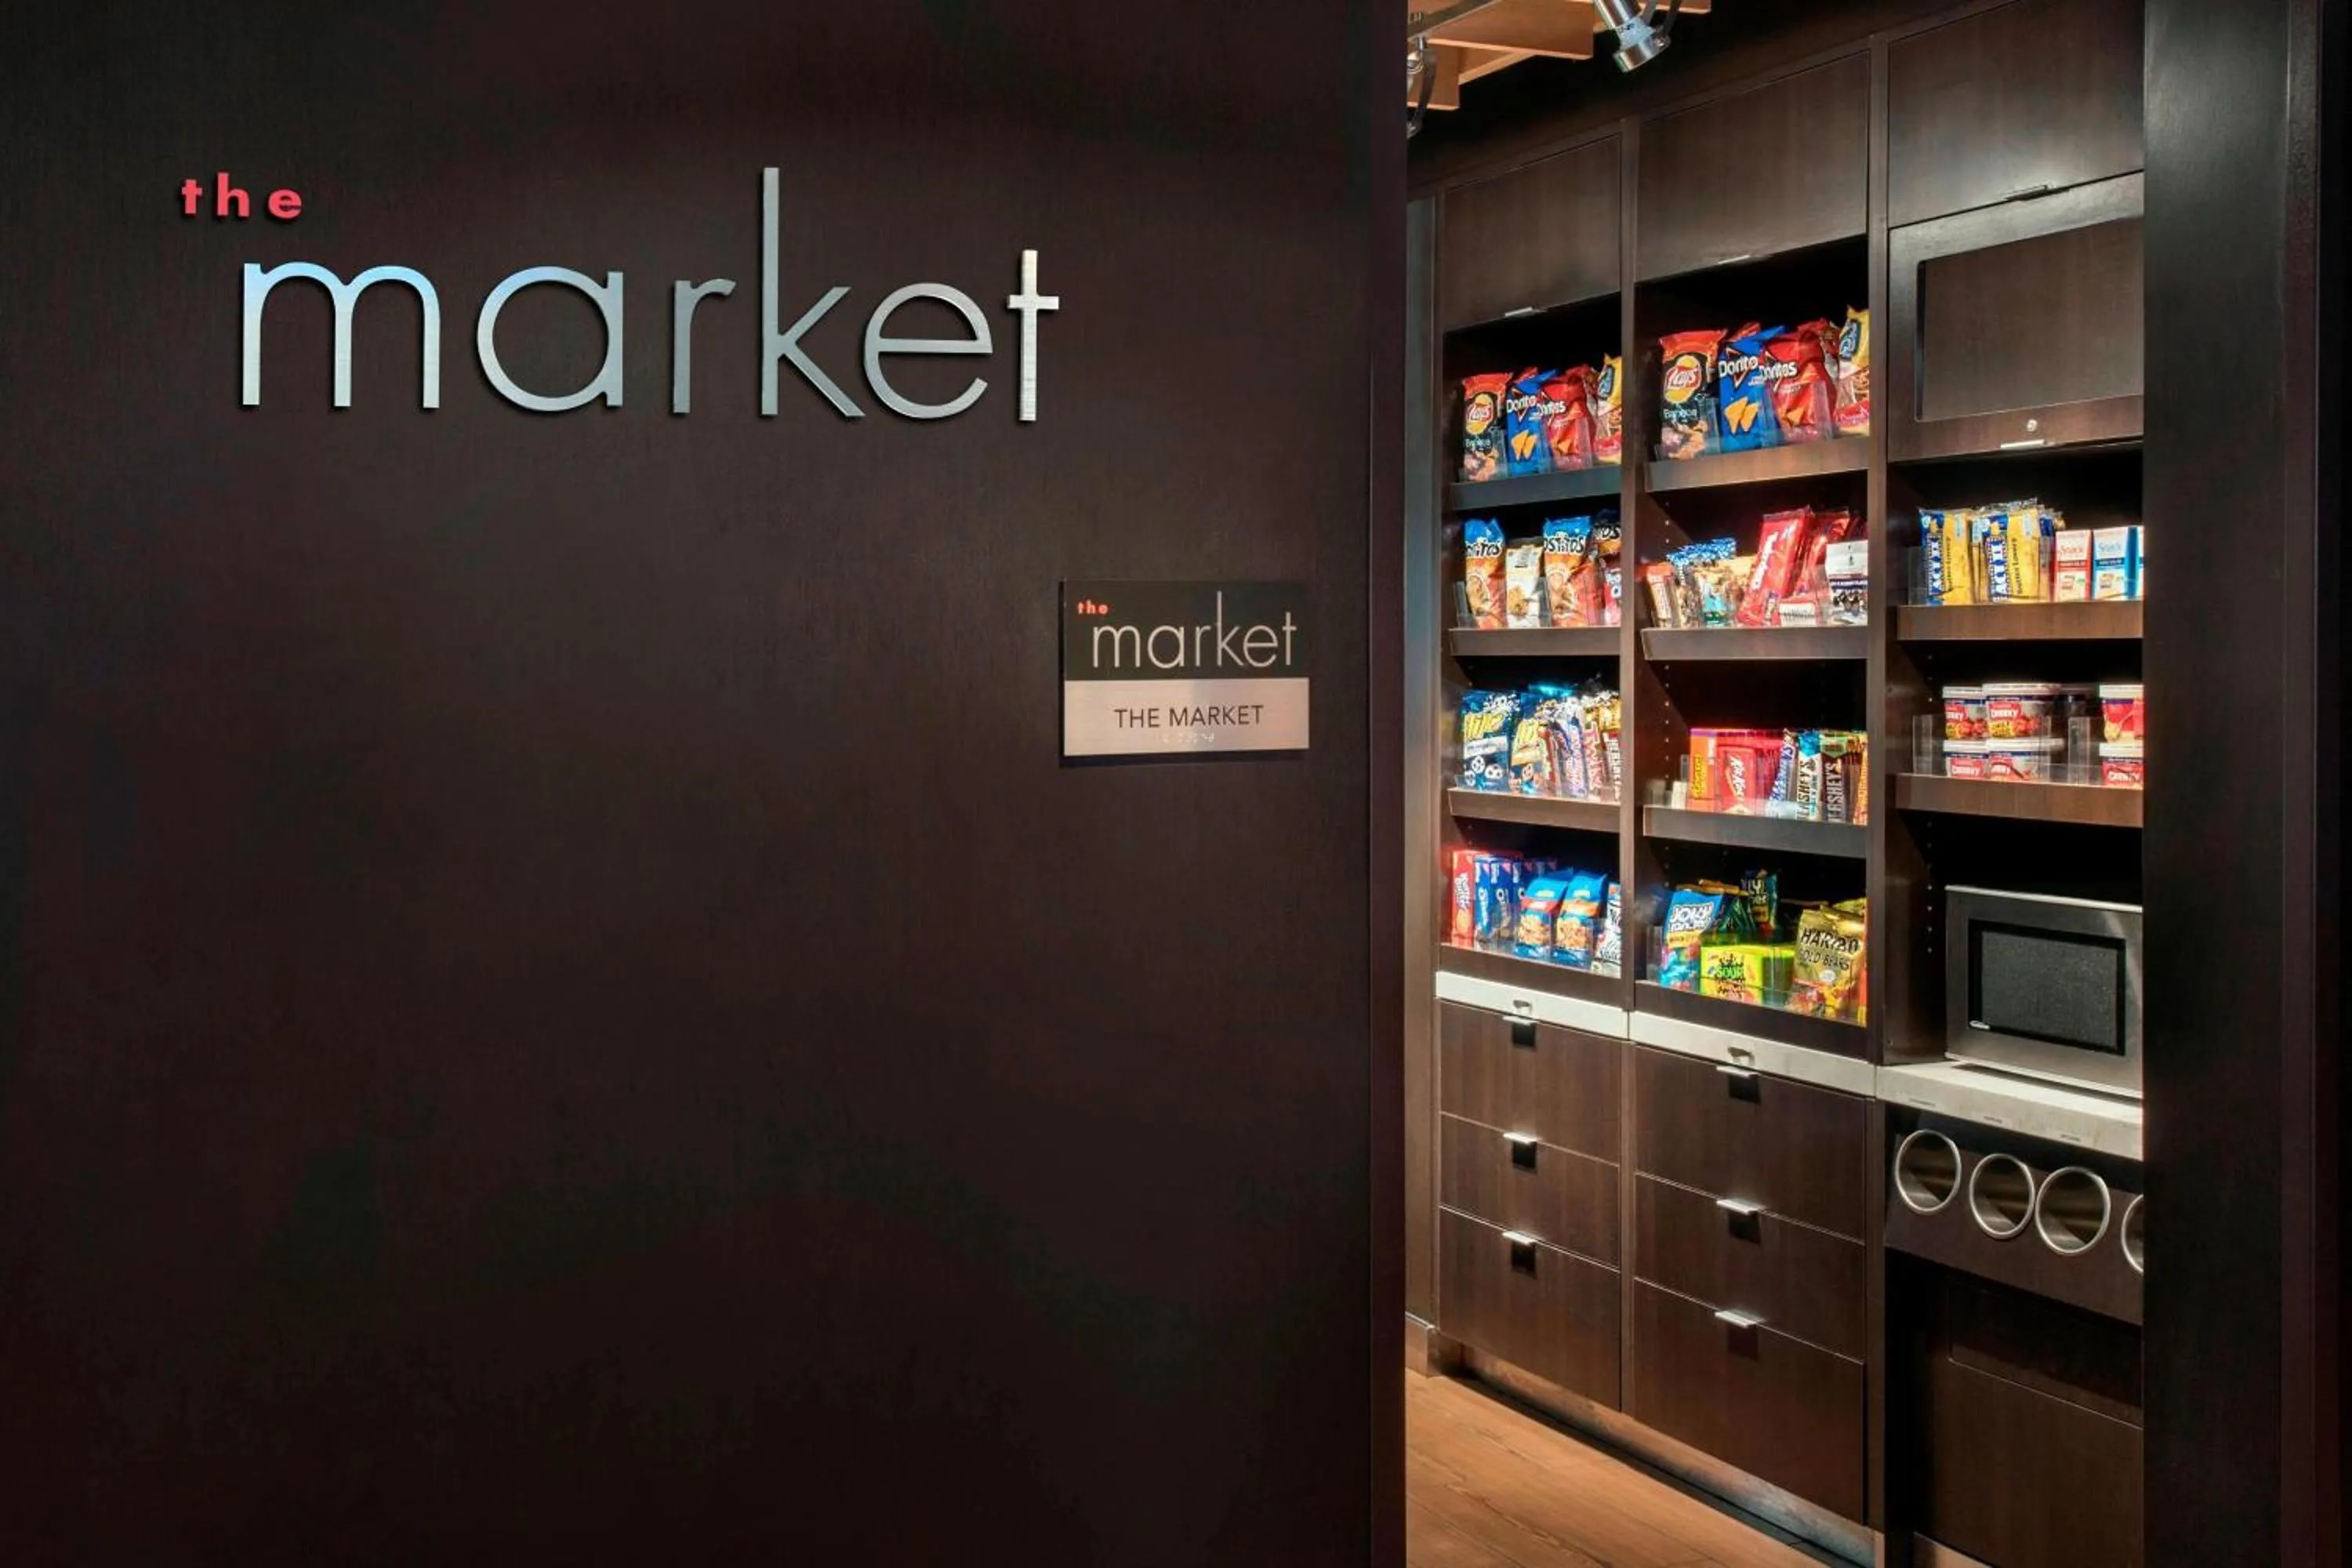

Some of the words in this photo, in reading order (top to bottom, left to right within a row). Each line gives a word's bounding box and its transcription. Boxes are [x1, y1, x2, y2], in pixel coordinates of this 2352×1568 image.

[181, 171, 303, 220] the
[242, 166, 1060, 423] market
[1718, 355, 1759, 378] Dorito
[1506, 394, 1537, 414] Dorito
[1077, 600, 1109, 615] the
[1093, 590, 1298, 668] market
[1114, 708, 1160, 728] THE
[1169, 705, 1264, 728] MARKET
